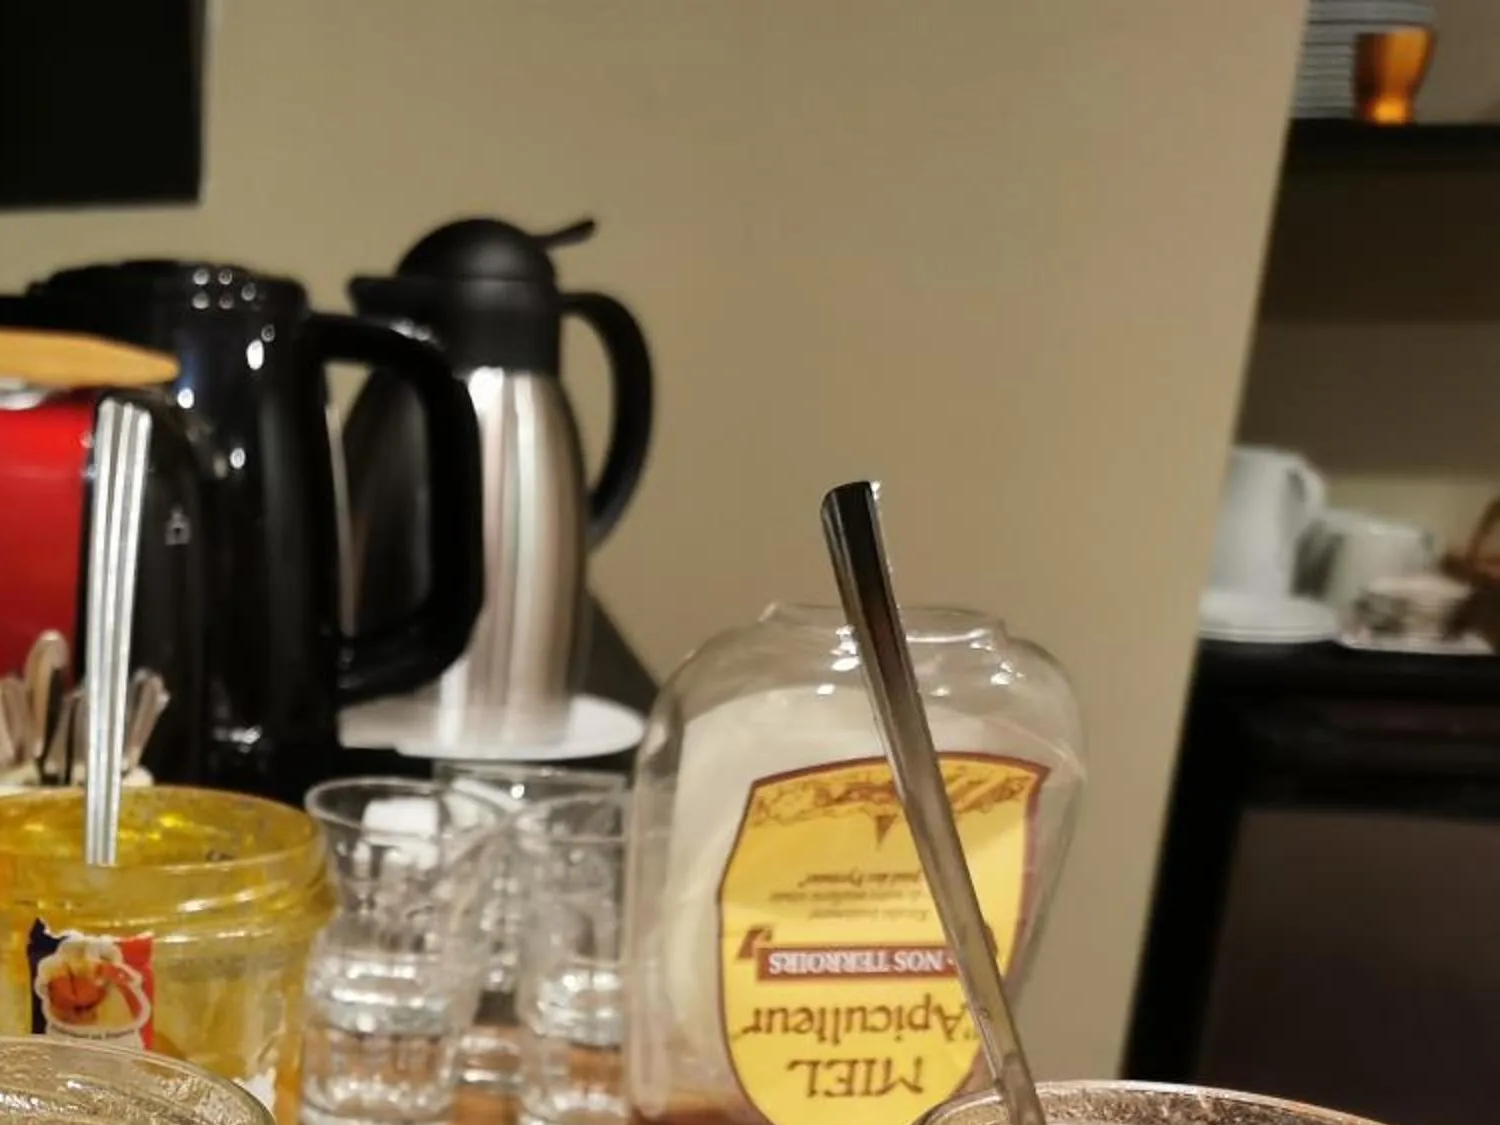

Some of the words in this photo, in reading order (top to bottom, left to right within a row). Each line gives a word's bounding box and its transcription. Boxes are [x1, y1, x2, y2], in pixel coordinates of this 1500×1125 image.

[768, 952, 892, 975] TERROIRS
[894, 951, 943, 973] NOS
[786, 1056, 924, 1099] MIEL
